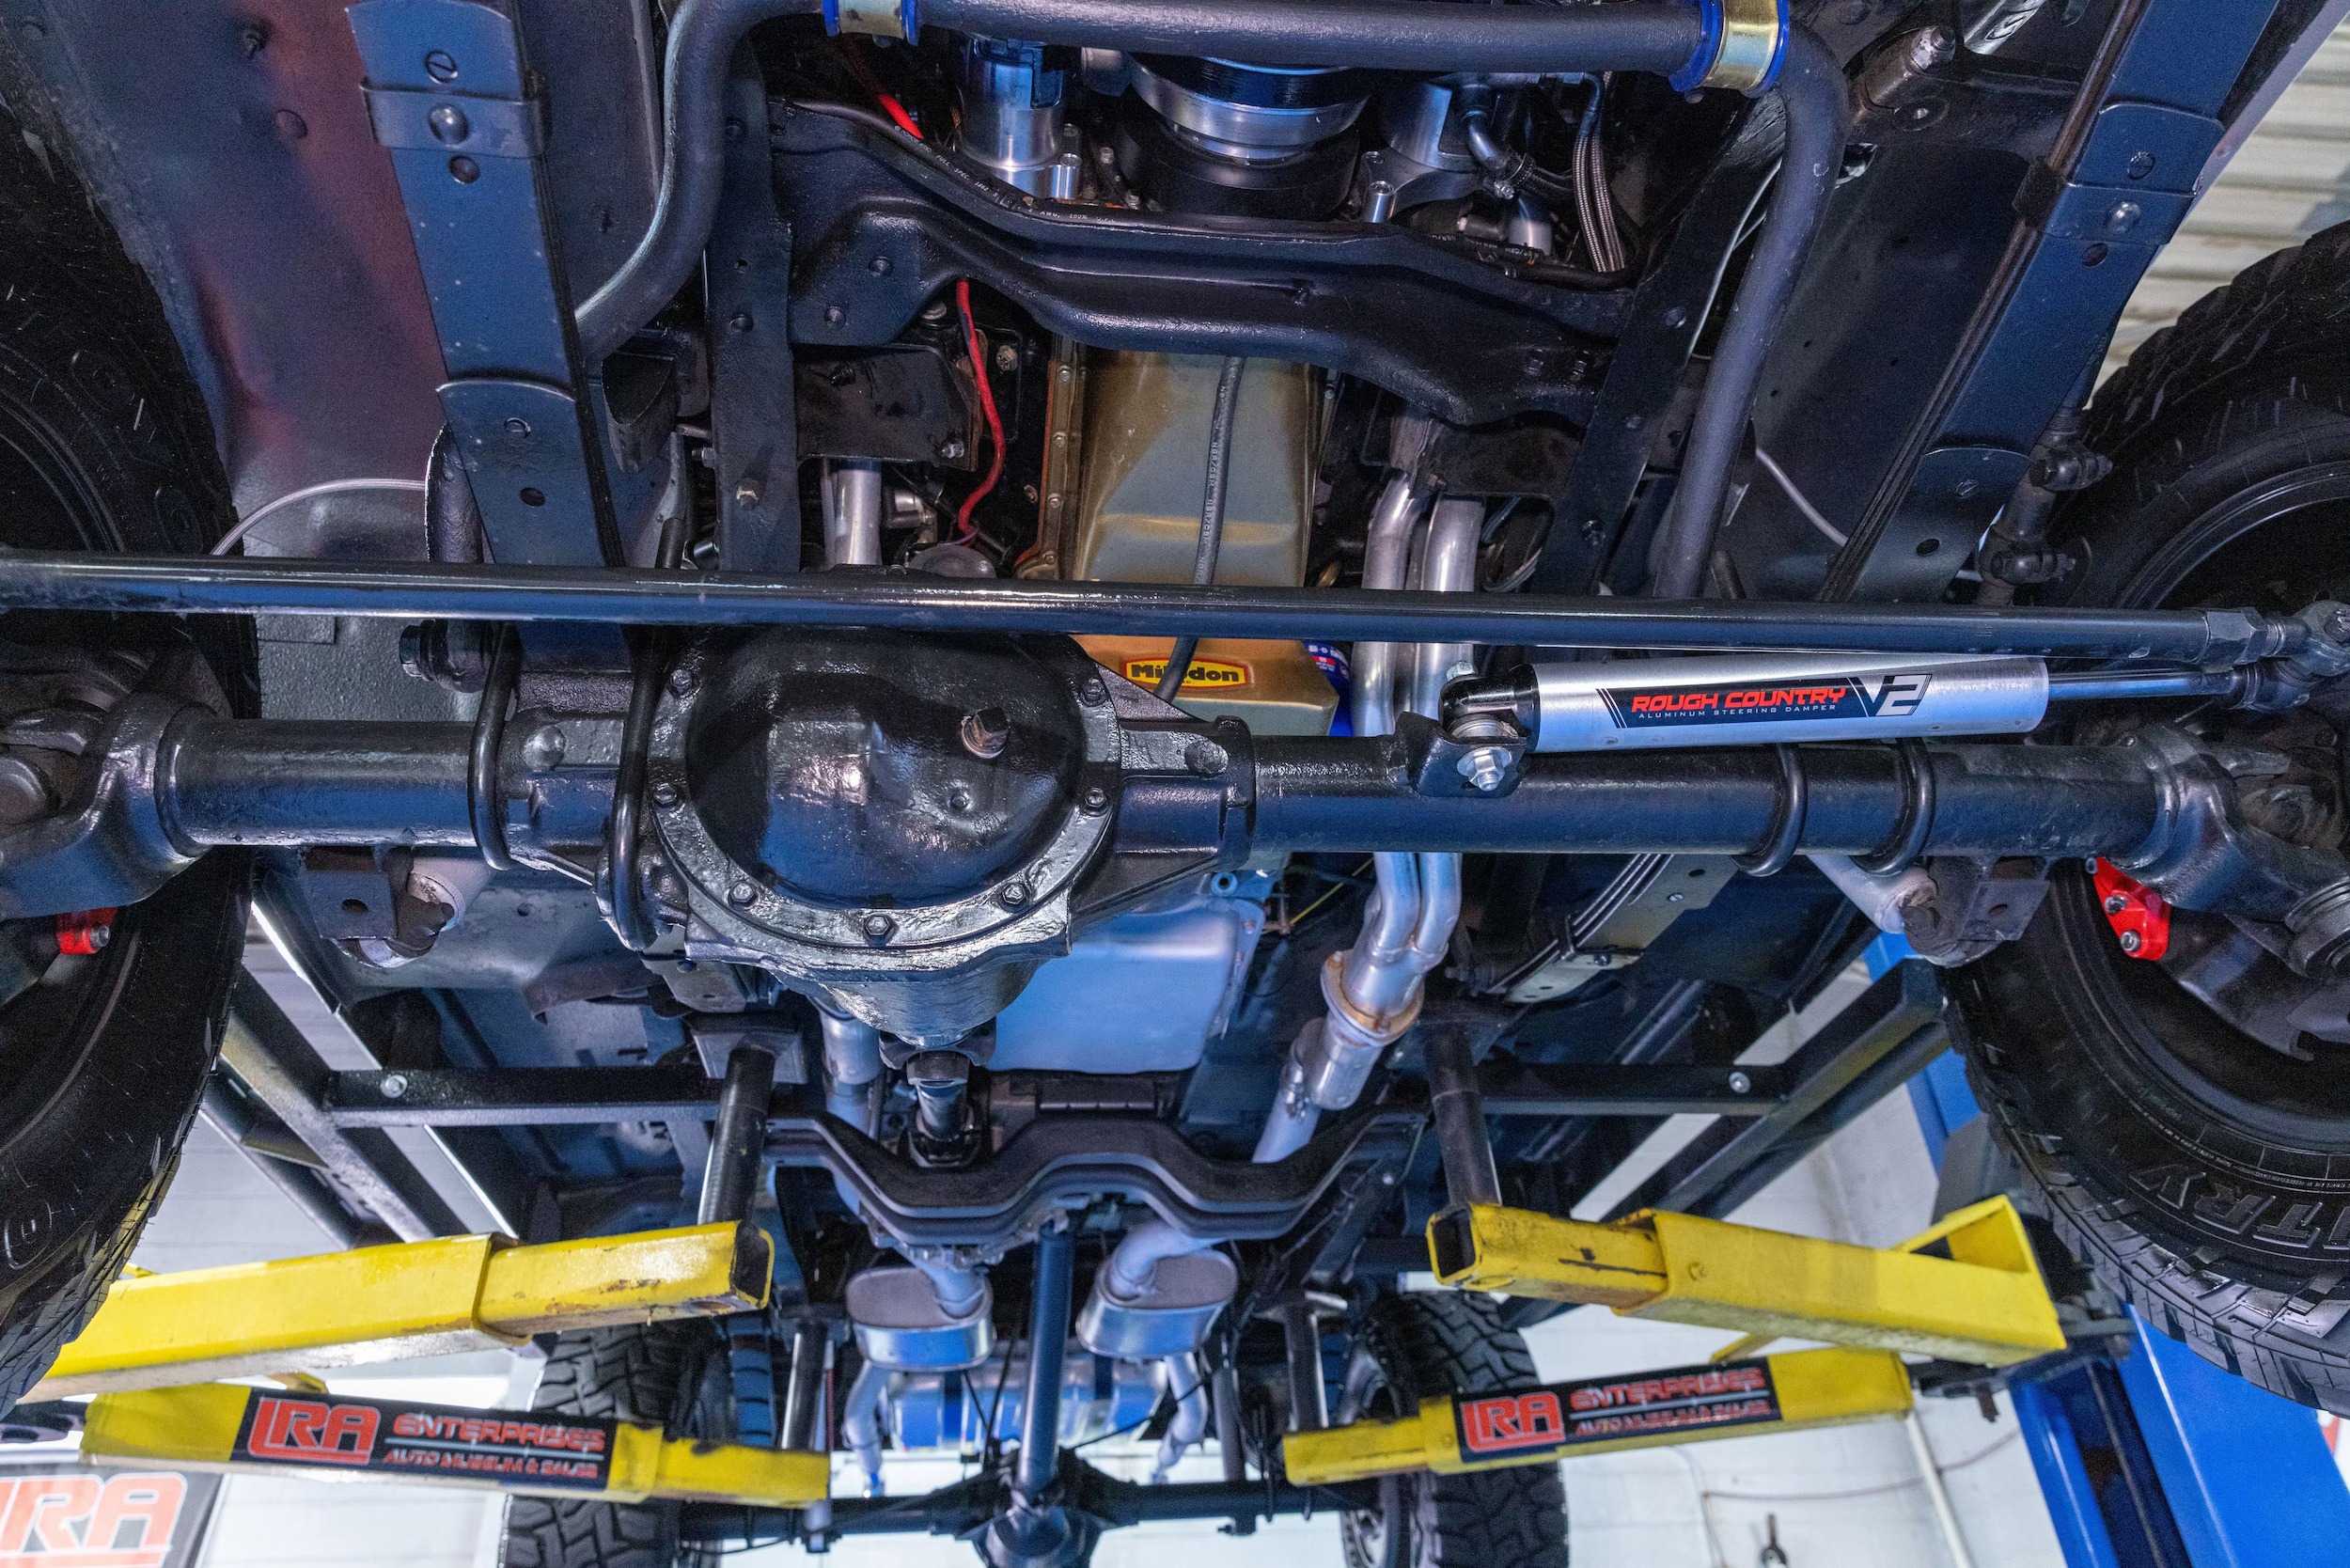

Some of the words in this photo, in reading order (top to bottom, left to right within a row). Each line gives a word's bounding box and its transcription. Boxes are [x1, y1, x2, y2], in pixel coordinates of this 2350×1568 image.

[1131, 664, 1239, 682] Midon
[1632, 692, 1716, 713] ROUGH
[1724, 687, 1846, 709] COUNTRY
[1638, 711, 1705, 719] ALUMINUM
[1714, 707, 1778, 715] STEERING
[1785, 704, 1836, 713] DAMPER
[1855, 674, 1932, 717] V2
[1569, 1368, 1766, 1411] ENTERPRISES
[248, 1396, 381, 1465] LRA
[393, 1413, 606, 1452] ENTERPRISES
[1460, 1390, 1566, 1452] LRA
[383, 1448, 440, 1466] AUTO
